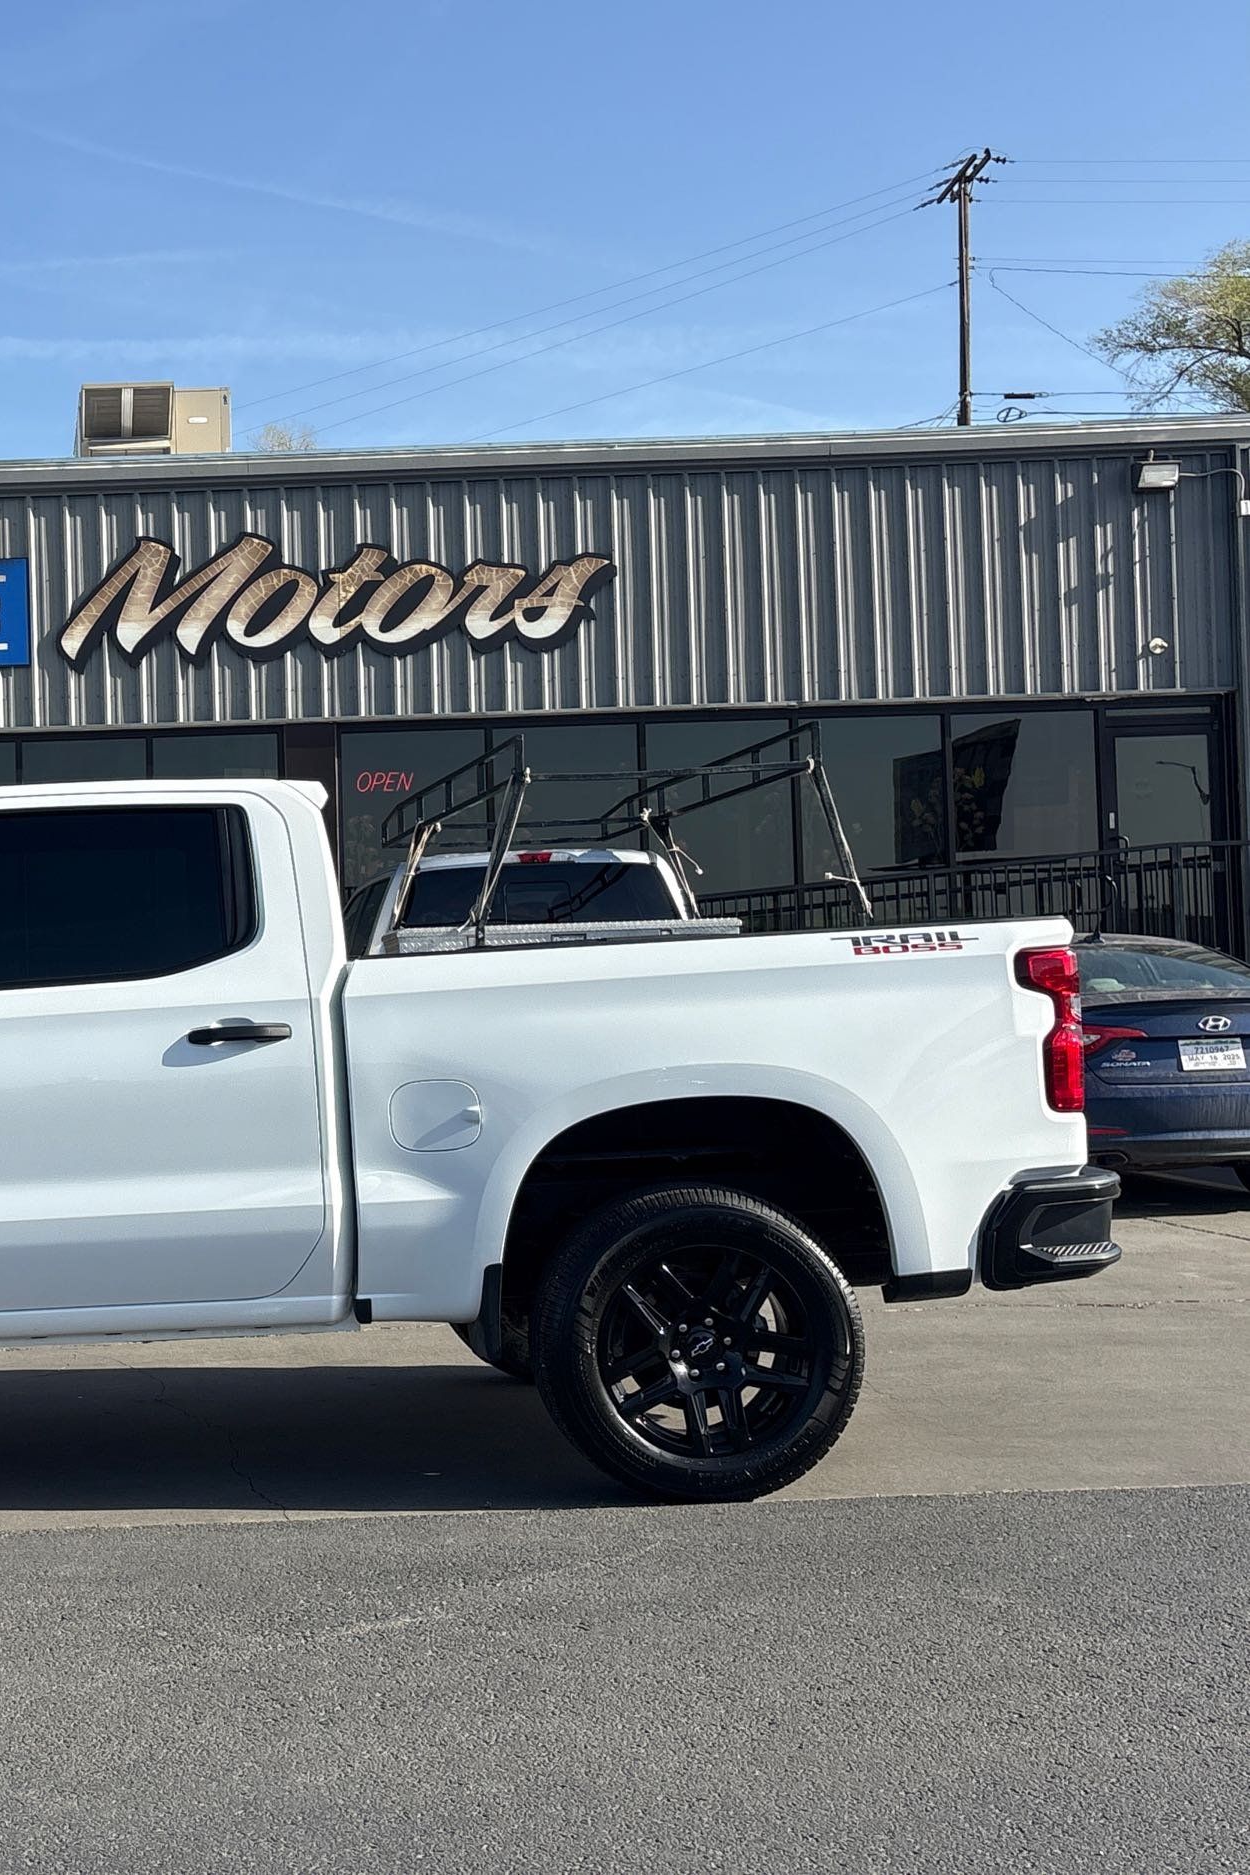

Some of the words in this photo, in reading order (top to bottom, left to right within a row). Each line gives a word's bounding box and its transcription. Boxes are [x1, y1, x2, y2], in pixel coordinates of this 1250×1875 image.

[58, 532, 617, 674] Motors
[356, 771, 415, 793] OPEN
[831, 931, 980, 946] TRAIL
[853, 942, 964, 956] BOSS
[1100, 1060, 1151, 1068] SONATA
